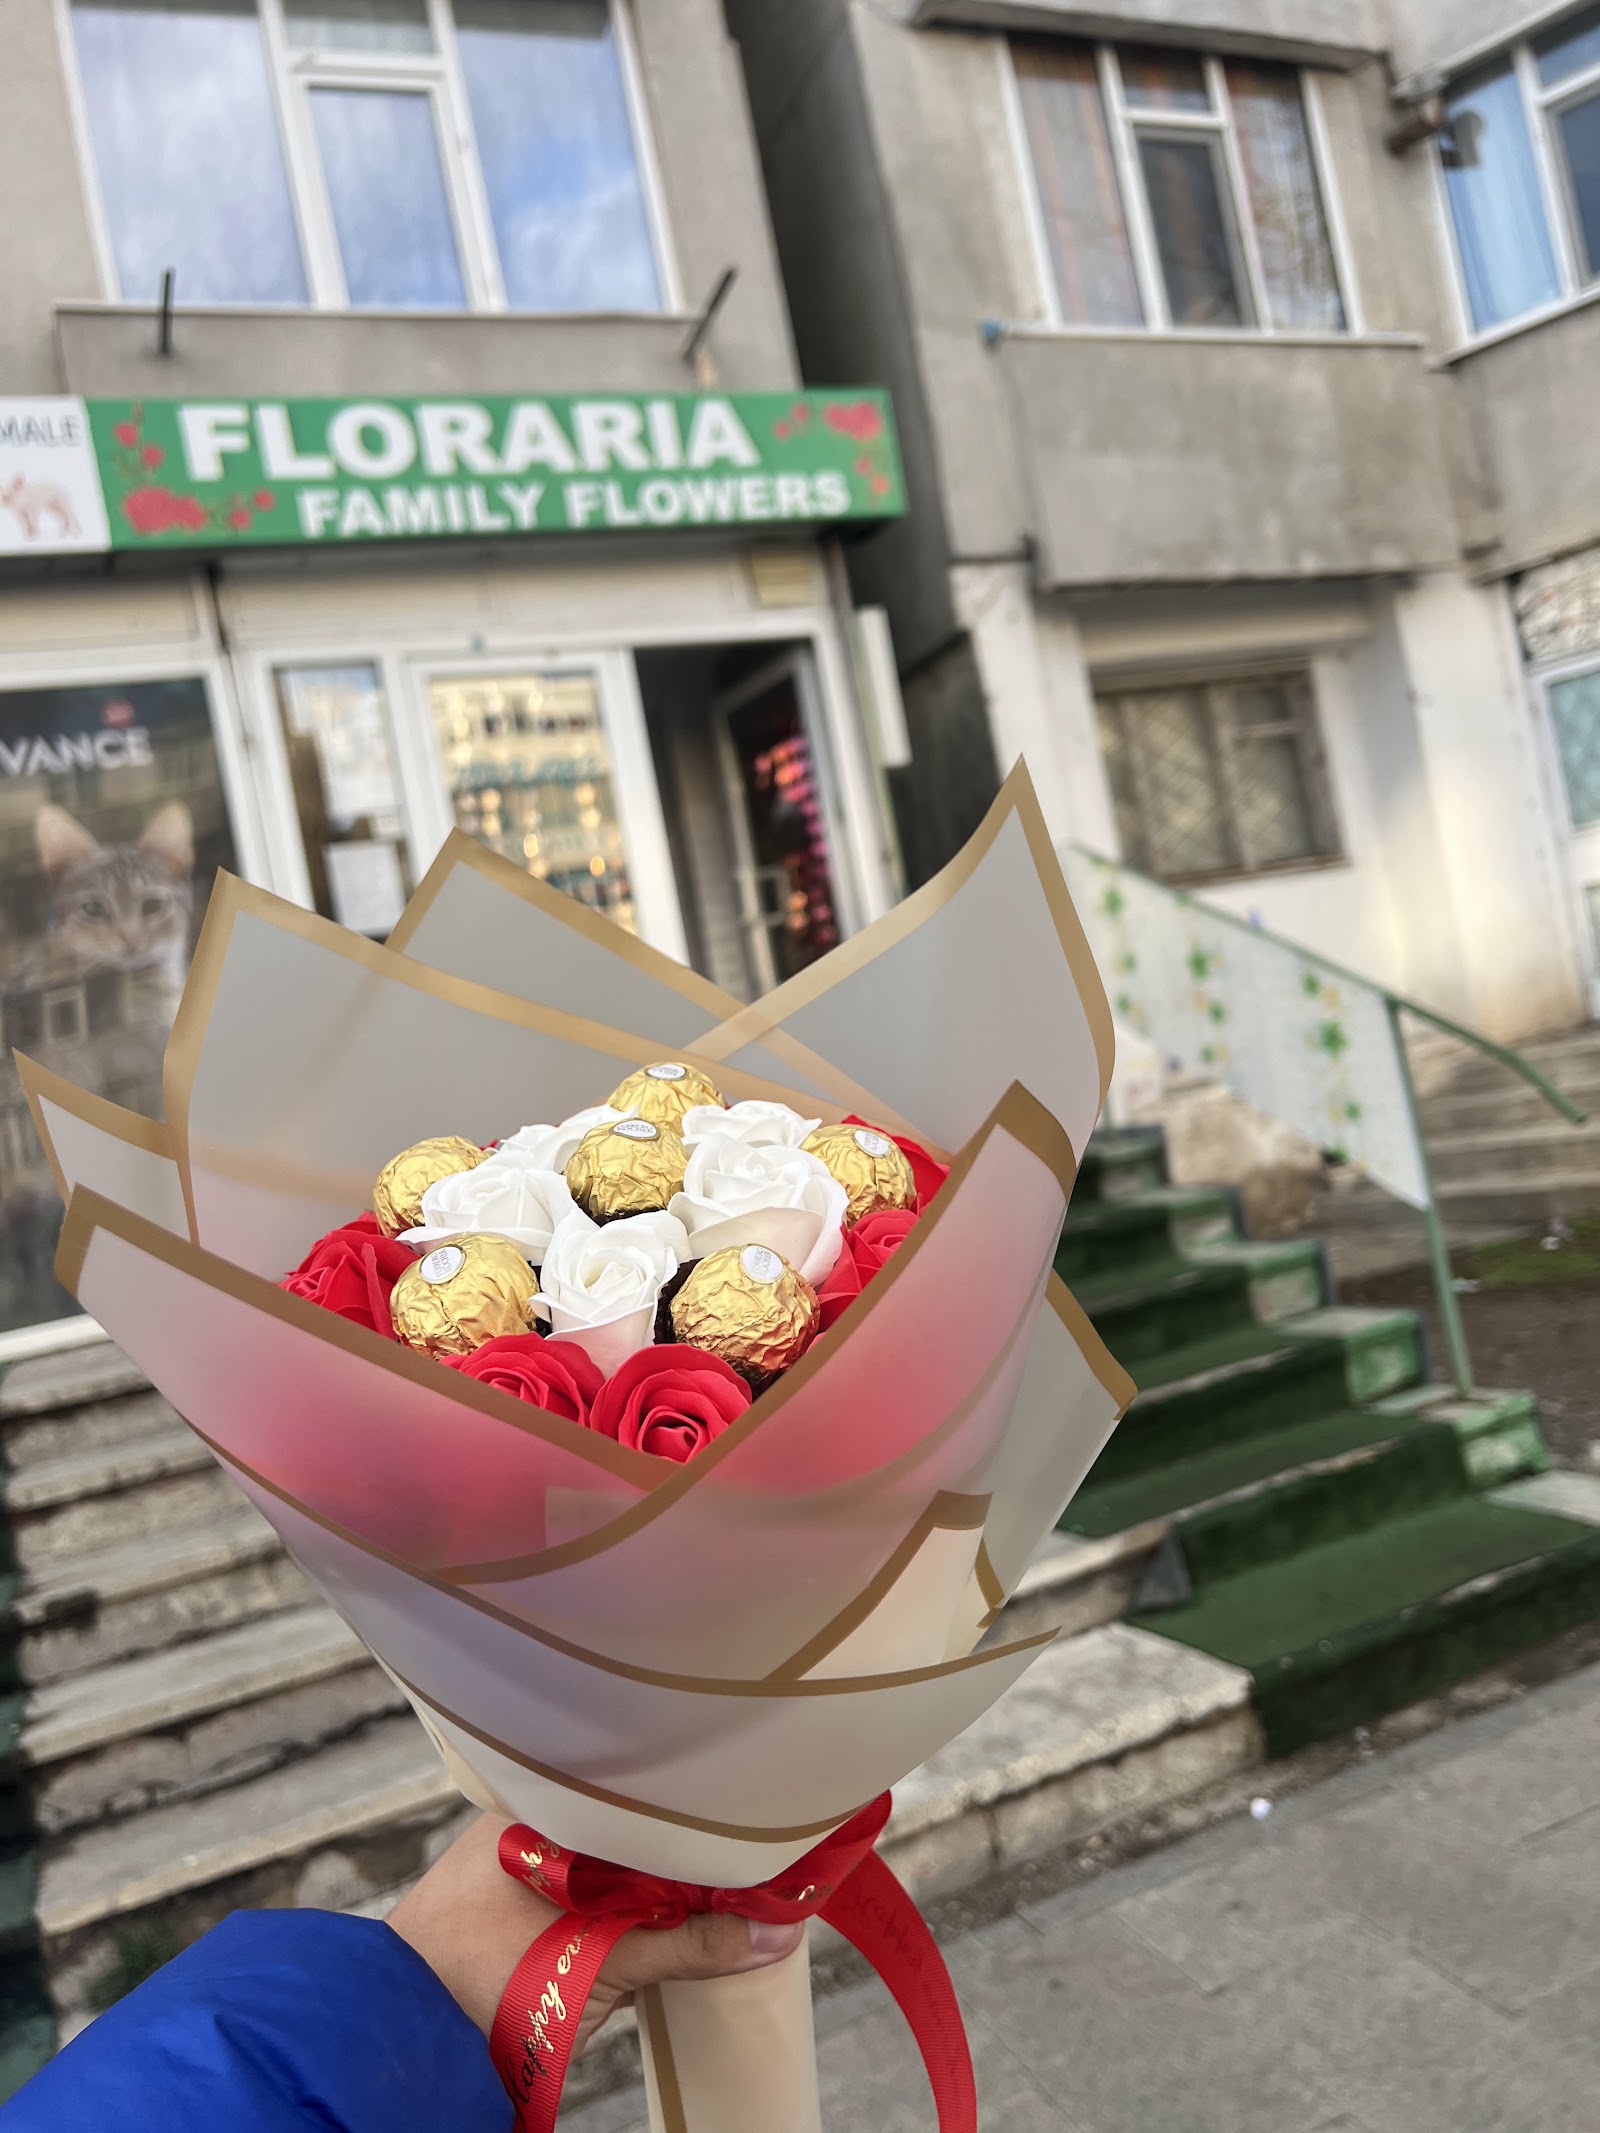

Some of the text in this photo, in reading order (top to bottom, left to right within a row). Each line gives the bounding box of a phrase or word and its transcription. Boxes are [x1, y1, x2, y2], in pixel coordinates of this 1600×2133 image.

[178, 400, 761, 482] FLORARIA
[300, 470, 851, 538] FAMILY FLOWERS
